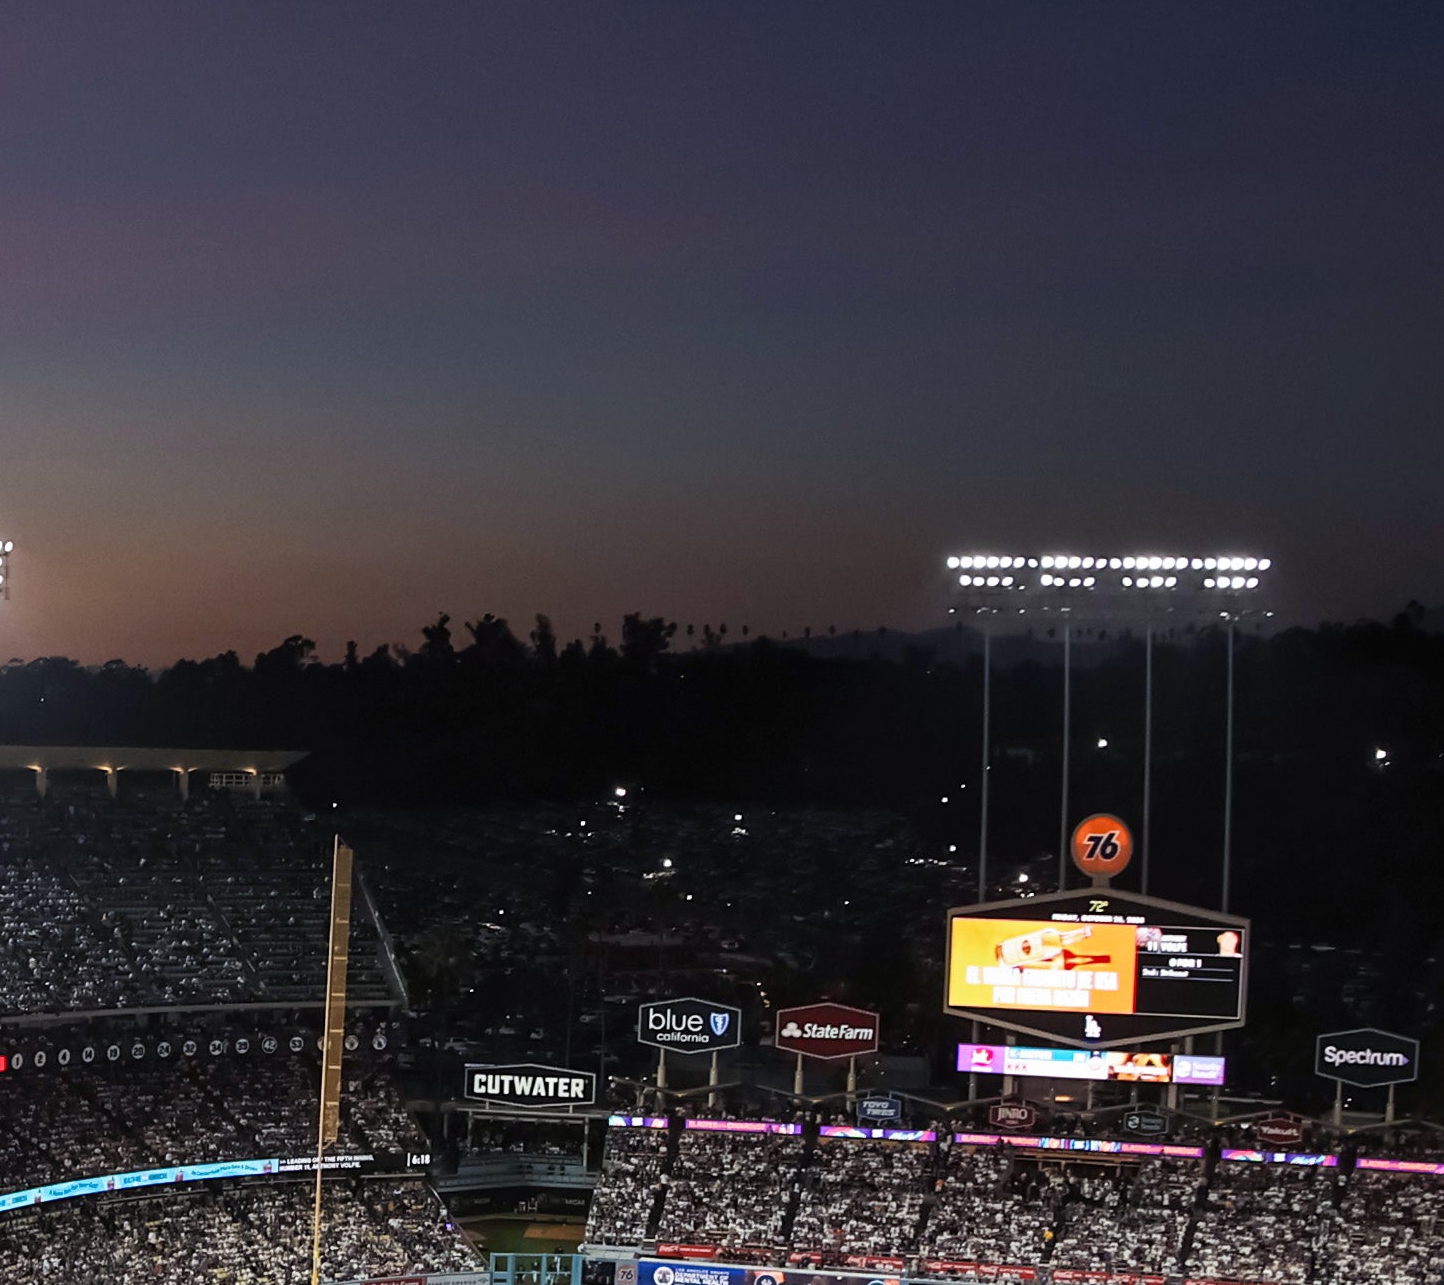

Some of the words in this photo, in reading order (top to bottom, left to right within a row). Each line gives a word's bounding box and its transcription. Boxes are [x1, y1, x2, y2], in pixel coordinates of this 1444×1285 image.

[1083, 831, 1120, 860] 76
[649, 1008, 703, 1032] blue
[657, 1032, 709, 1043] california
[1324, 1046, 1403, 1067] Spectrum
[473, 1074, 585, 1099] CUTWATER
[997, 1108, 1028, 1121] JINRO
[412, 1154, 430, 1165] 6:18
[619, 1268, 633, 1280] 76
